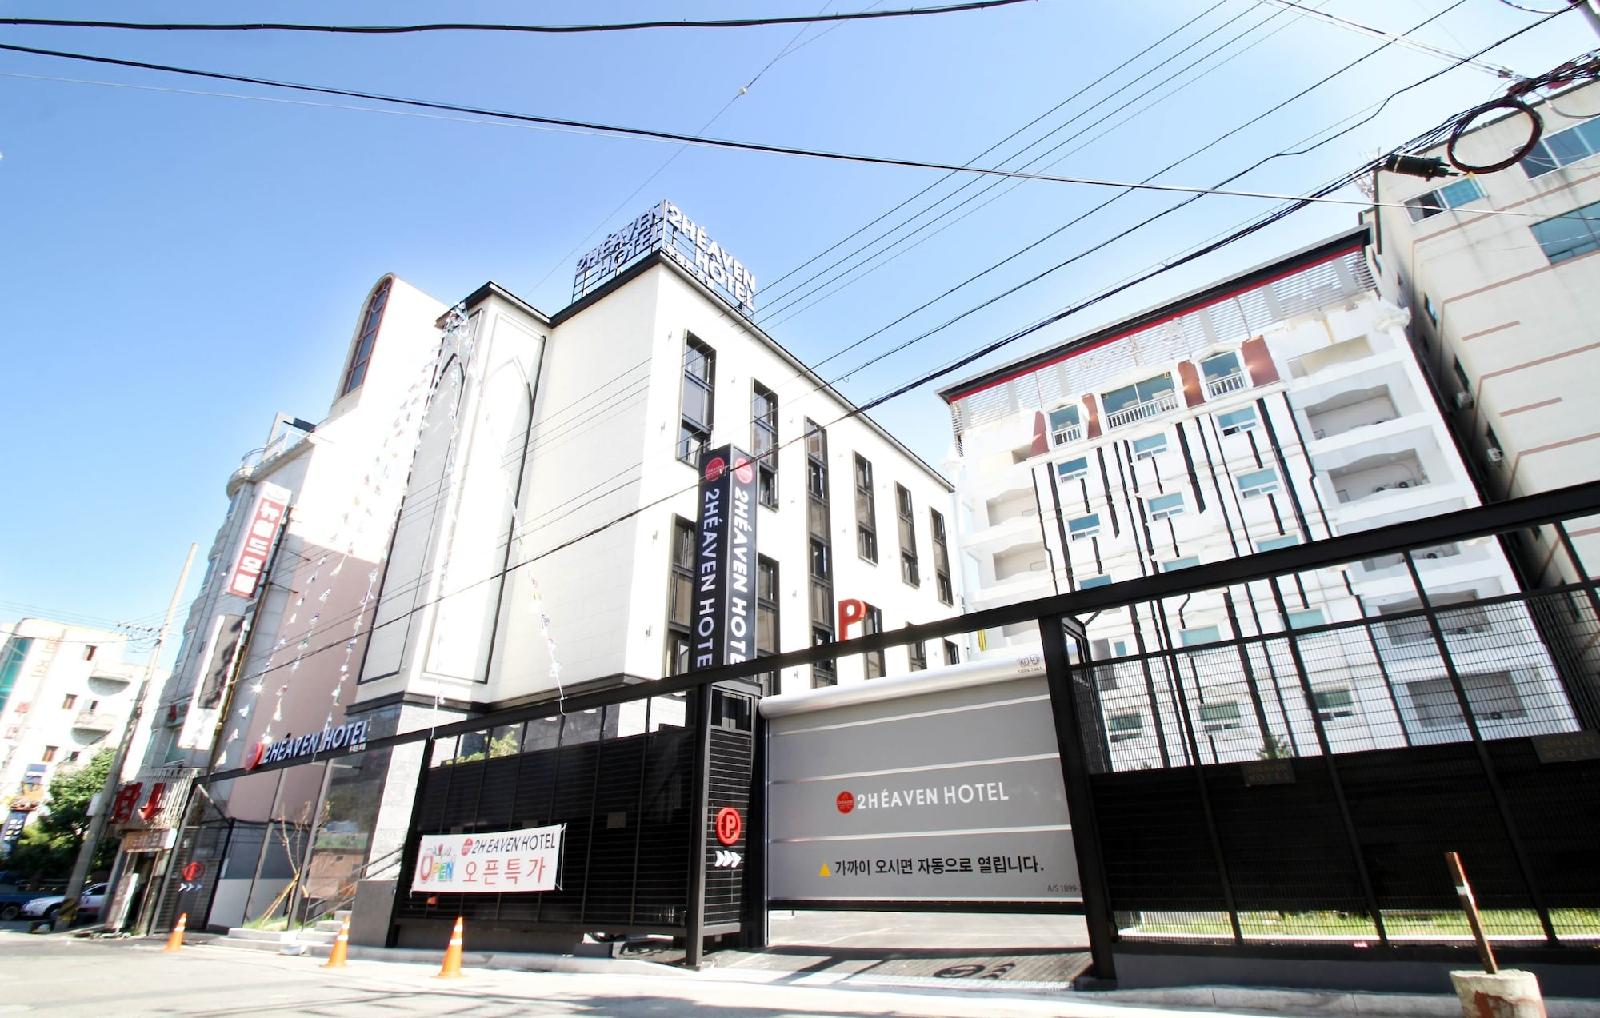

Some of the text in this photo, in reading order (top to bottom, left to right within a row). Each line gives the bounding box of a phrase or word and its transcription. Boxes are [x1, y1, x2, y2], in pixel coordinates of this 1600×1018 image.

[667, 204, 756, 295] 2HÉAVEN
[695, 246, 755, 312] HOTEL
[697, 488, 723, 669] 2HÉAVEN HOTE
[730, 486, 753, 666] 2HÉAVEN HOTE
[838, 598, 866, 641] P
[322, 720, 367, 751] HOTEL
[857, 788, 938, 809] 2HÉAVEN
[943, 781, 1009, 804] HOTEL
[725, 814, 737, 838] P
[520, 832, 556, 851] HOTEL
[420, 854, 455, 883] OPEN
[463, 856, 546, 885] 오픈특가
[835, 855, 1044, 876] 가까이 오시면 자동으로 열립니다.
